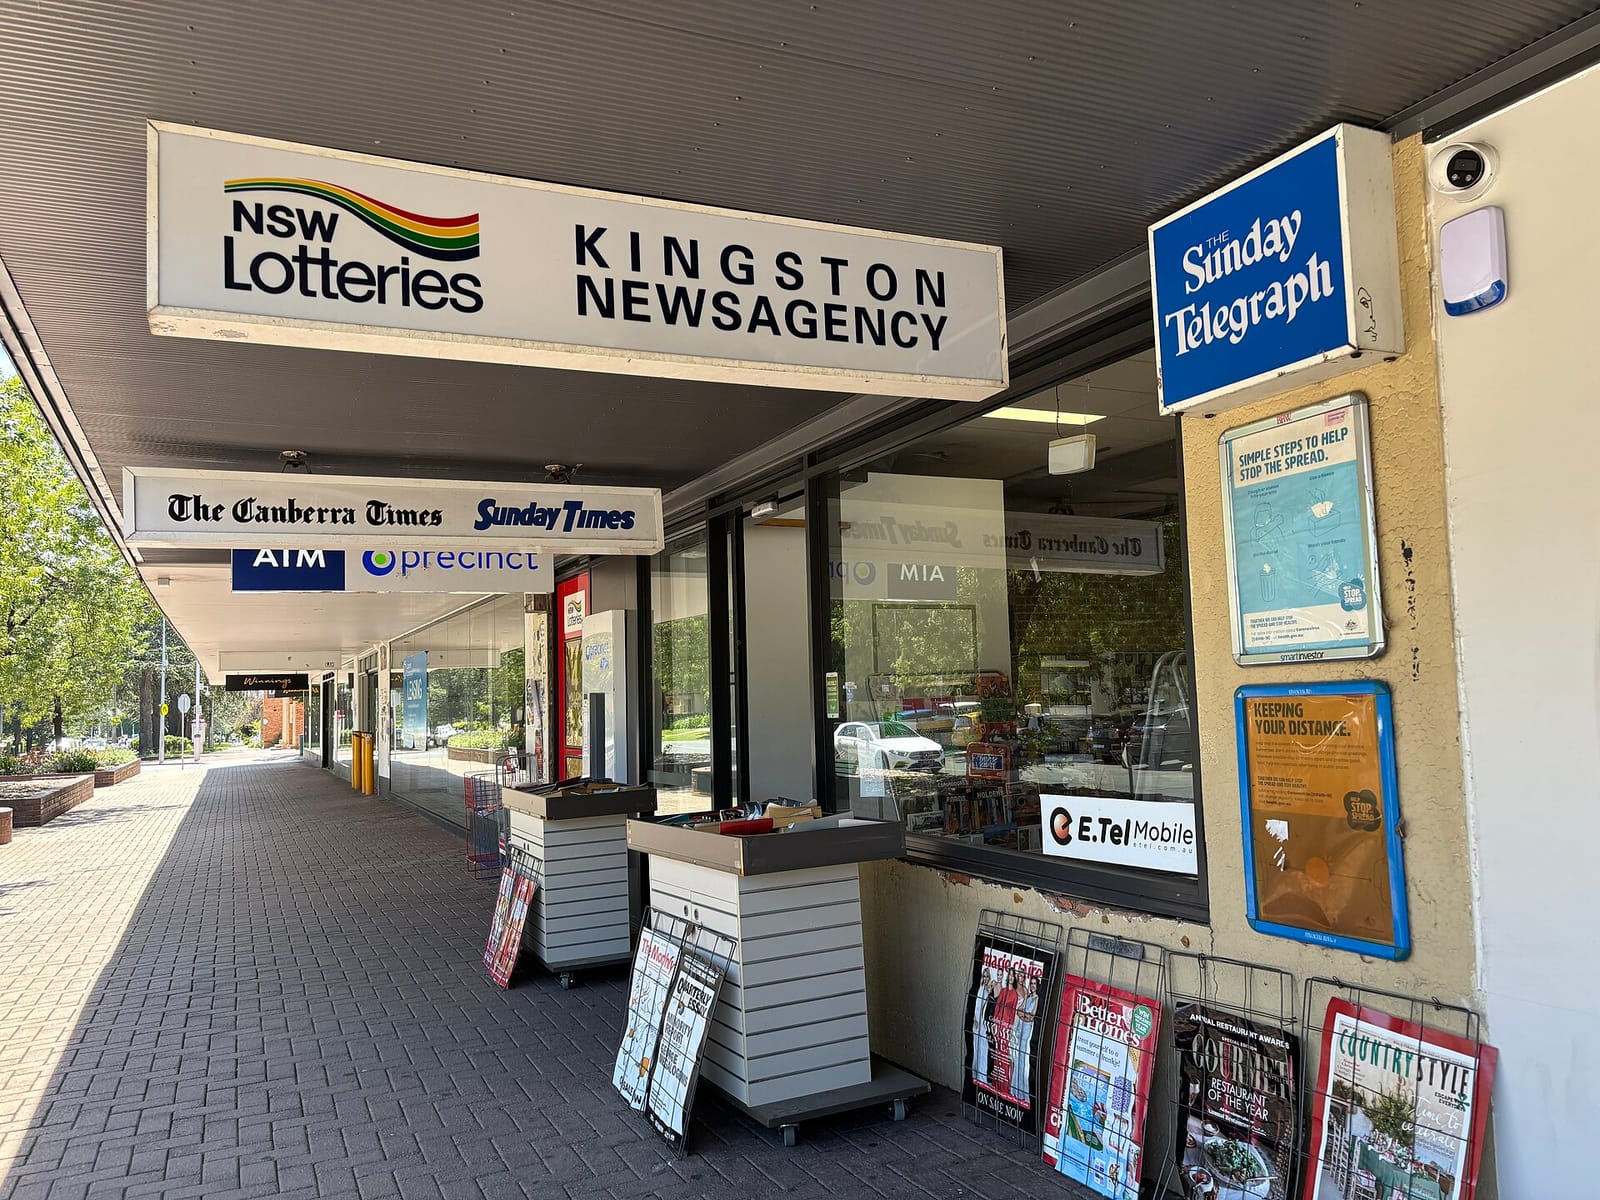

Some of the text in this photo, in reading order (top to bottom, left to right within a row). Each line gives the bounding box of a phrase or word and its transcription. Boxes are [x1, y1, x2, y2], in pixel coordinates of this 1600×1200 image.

[233, 200, 339, 243] NSW
[1182, 209, 1302, 295] Sunday
[1206, 229, 1230, 249] THE
[223, 236, 484, 314] Lotteries
[574, 224, 947, 308] KINGSTON
[576, 274, 948, 351] NEWSAGENCY
[1165, 251, 1336, 357] Telegraph
[1239, 427, 1349, 467] SIMPLE STEPS TO HELP
[1240, 449, 1329, 481] STOP THE SPREAD.
[168, 494, 443, 527] The Canberra Times
[473, 498, 635, 532] Sunday Times
[401, 550, 539, 577] precinct
[1254, 703, 1303, 718] KEEPING
[1255, 720, 1351, 736] YOUR DISTANCE.
[1351, 802, 1372, 813] STOP
[1078, 816, 1193, 846] E.Tel Mobile
[1133, 842, 1193, 854] etel.com.au
[650, 945, 676, 975] Monthly
[983, 953, 1044, 979] marie claire
[1077, 994, 1125, 1027] Better
[1086, 1015, 1140, 1047] Homes
[1217, 1021, 1258, 1040] RESTAURANT
[1339, 1028, 1414, 1078] COUNTRY
[1416, 1055, 1469, 1096] STYLE
[977, 1092, 988, 1106] ON
[1005, 1105, 1024, 1122] NOW
[1208, 1088, 1221, 1102] OF
[1224, 1094, 1242, 1110] THE
[1245, 1101, 1269, 1121] YEAR
[1211, 1077, 1267, 1107] RESTAURANT
